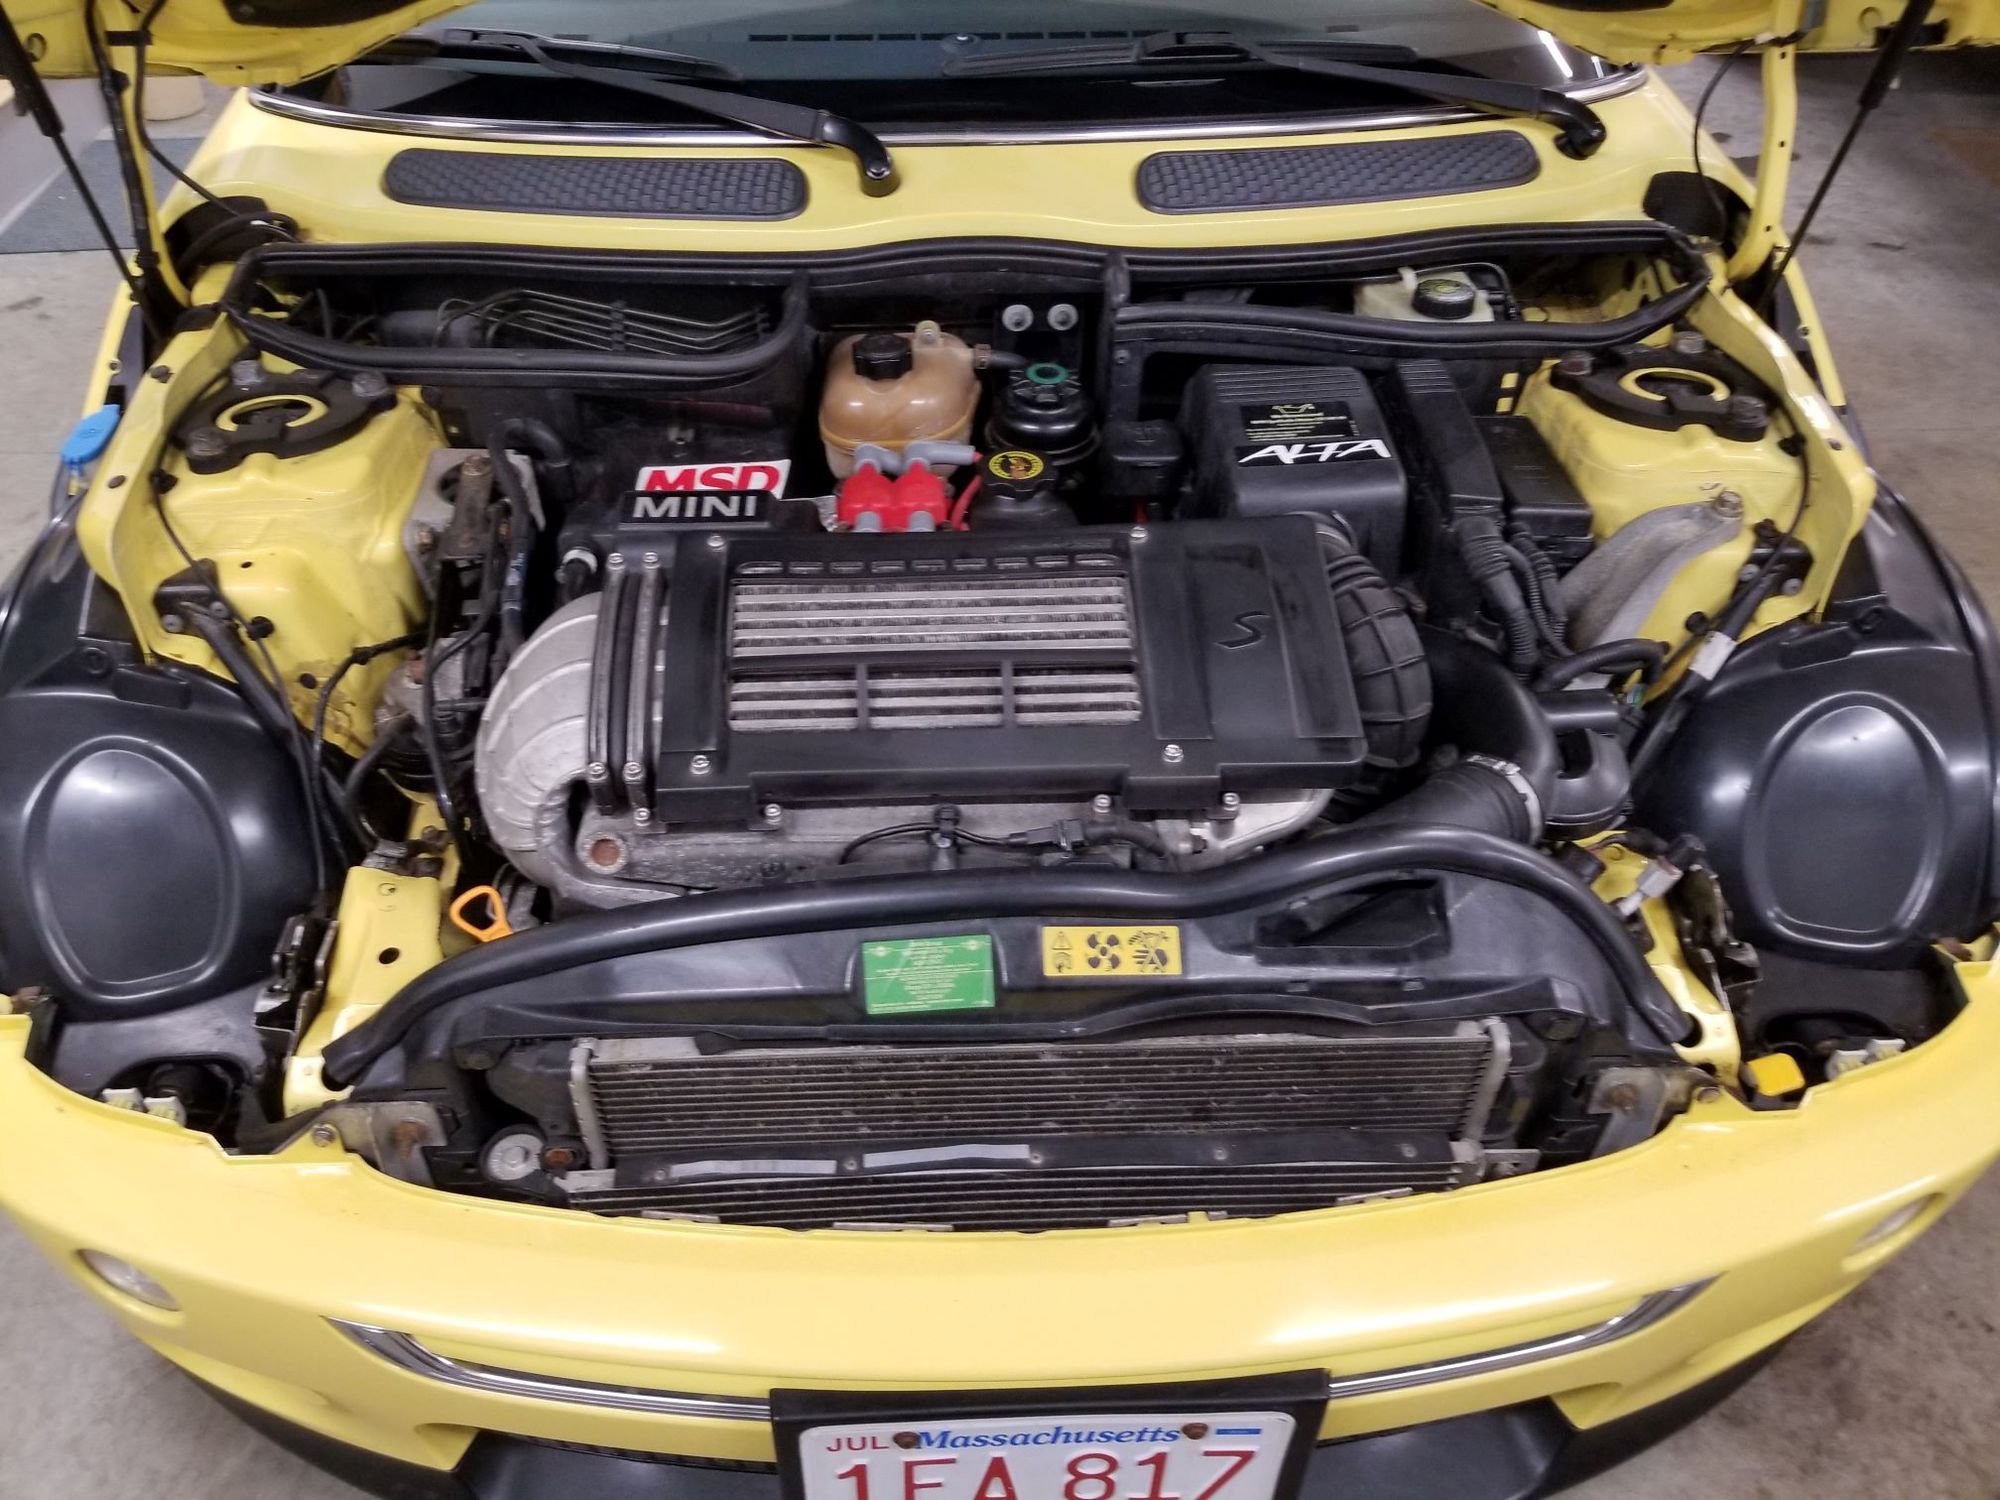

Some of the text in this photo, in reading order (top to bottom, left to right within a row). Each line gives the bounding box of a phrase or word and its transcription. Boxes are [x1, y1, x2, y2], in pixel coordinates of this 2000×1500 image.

[1239, 439, 1392, 465] ALTA
[644, 465, 780, 491] MSD
[632, 495, 757, 518] MINI
[1214, 611, 1271, 649] S
[826, 1436, 889, 1452] JUL
[915, 1426, 1181, 1449] Massachusetts
[1064, 1450, 1255, 1500] 817
